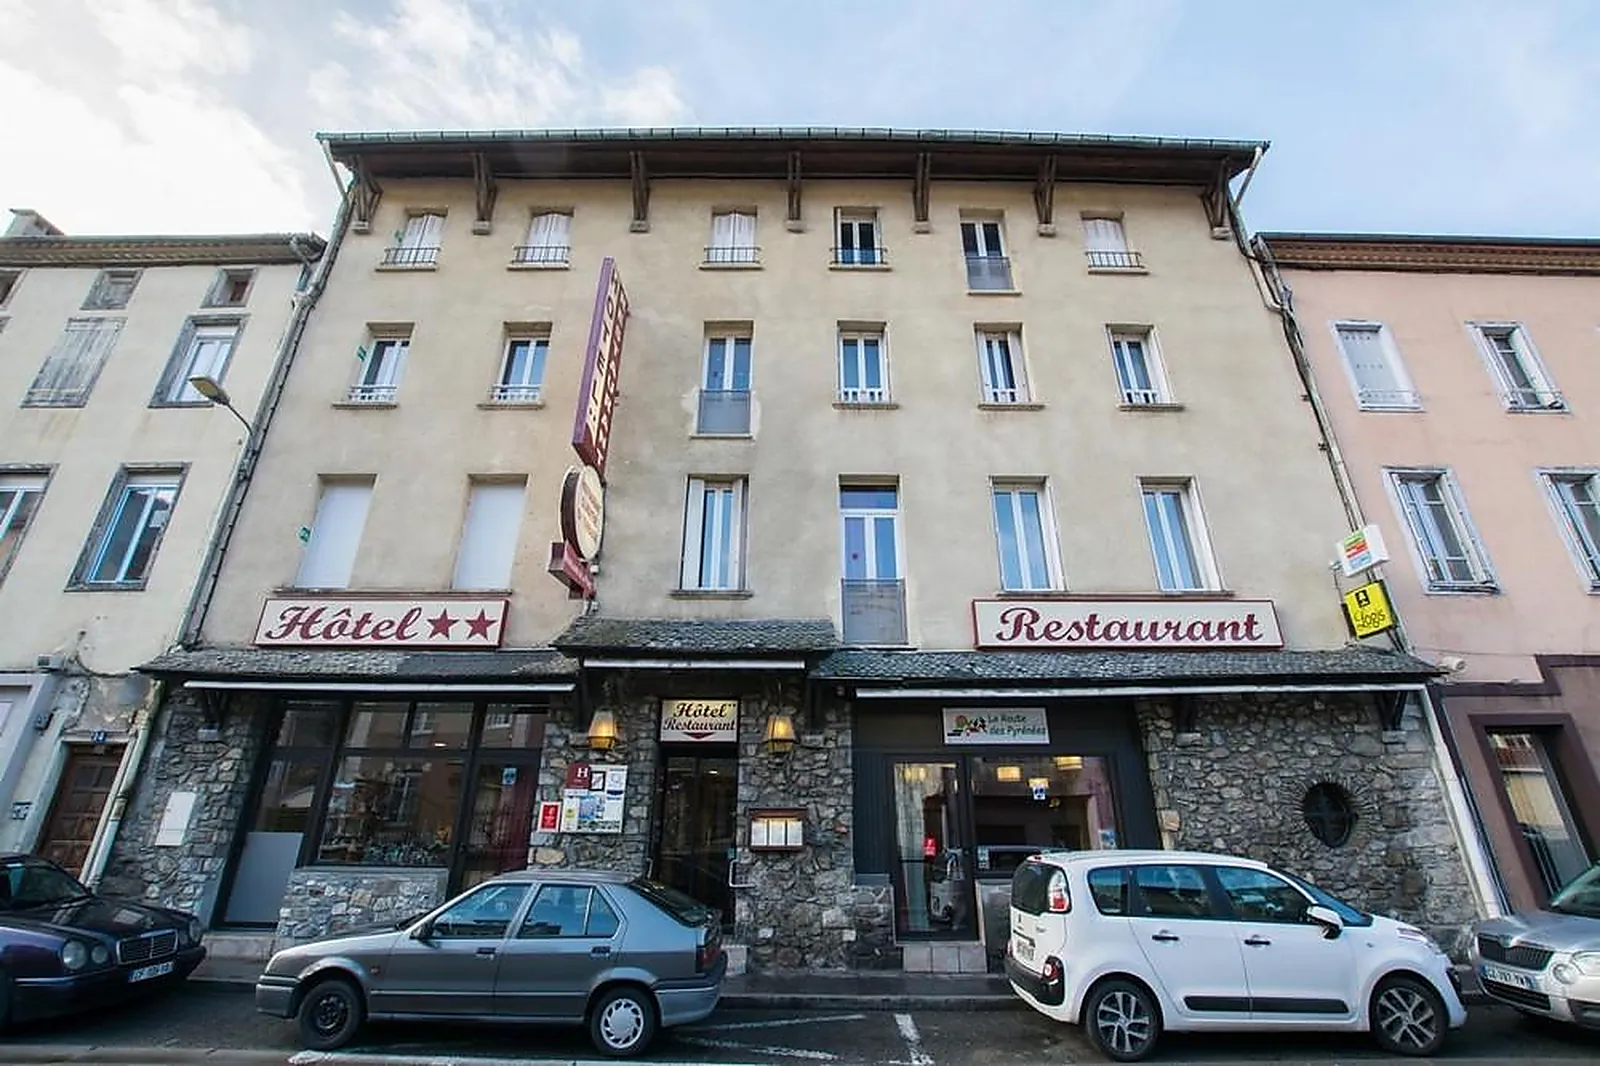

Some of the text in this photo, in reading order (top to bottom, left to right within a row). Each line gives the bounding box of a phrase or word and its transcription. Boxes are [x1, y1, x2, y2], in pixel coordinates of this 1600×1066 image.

[265, 606, 422, 641] Hôtel
[996, 606, 1263, 641] Restaurant
[673, 703, 728, 718] Hôtel
[663, 718, 736, 731] Restaurant
[577, 767, 589, 778] H
